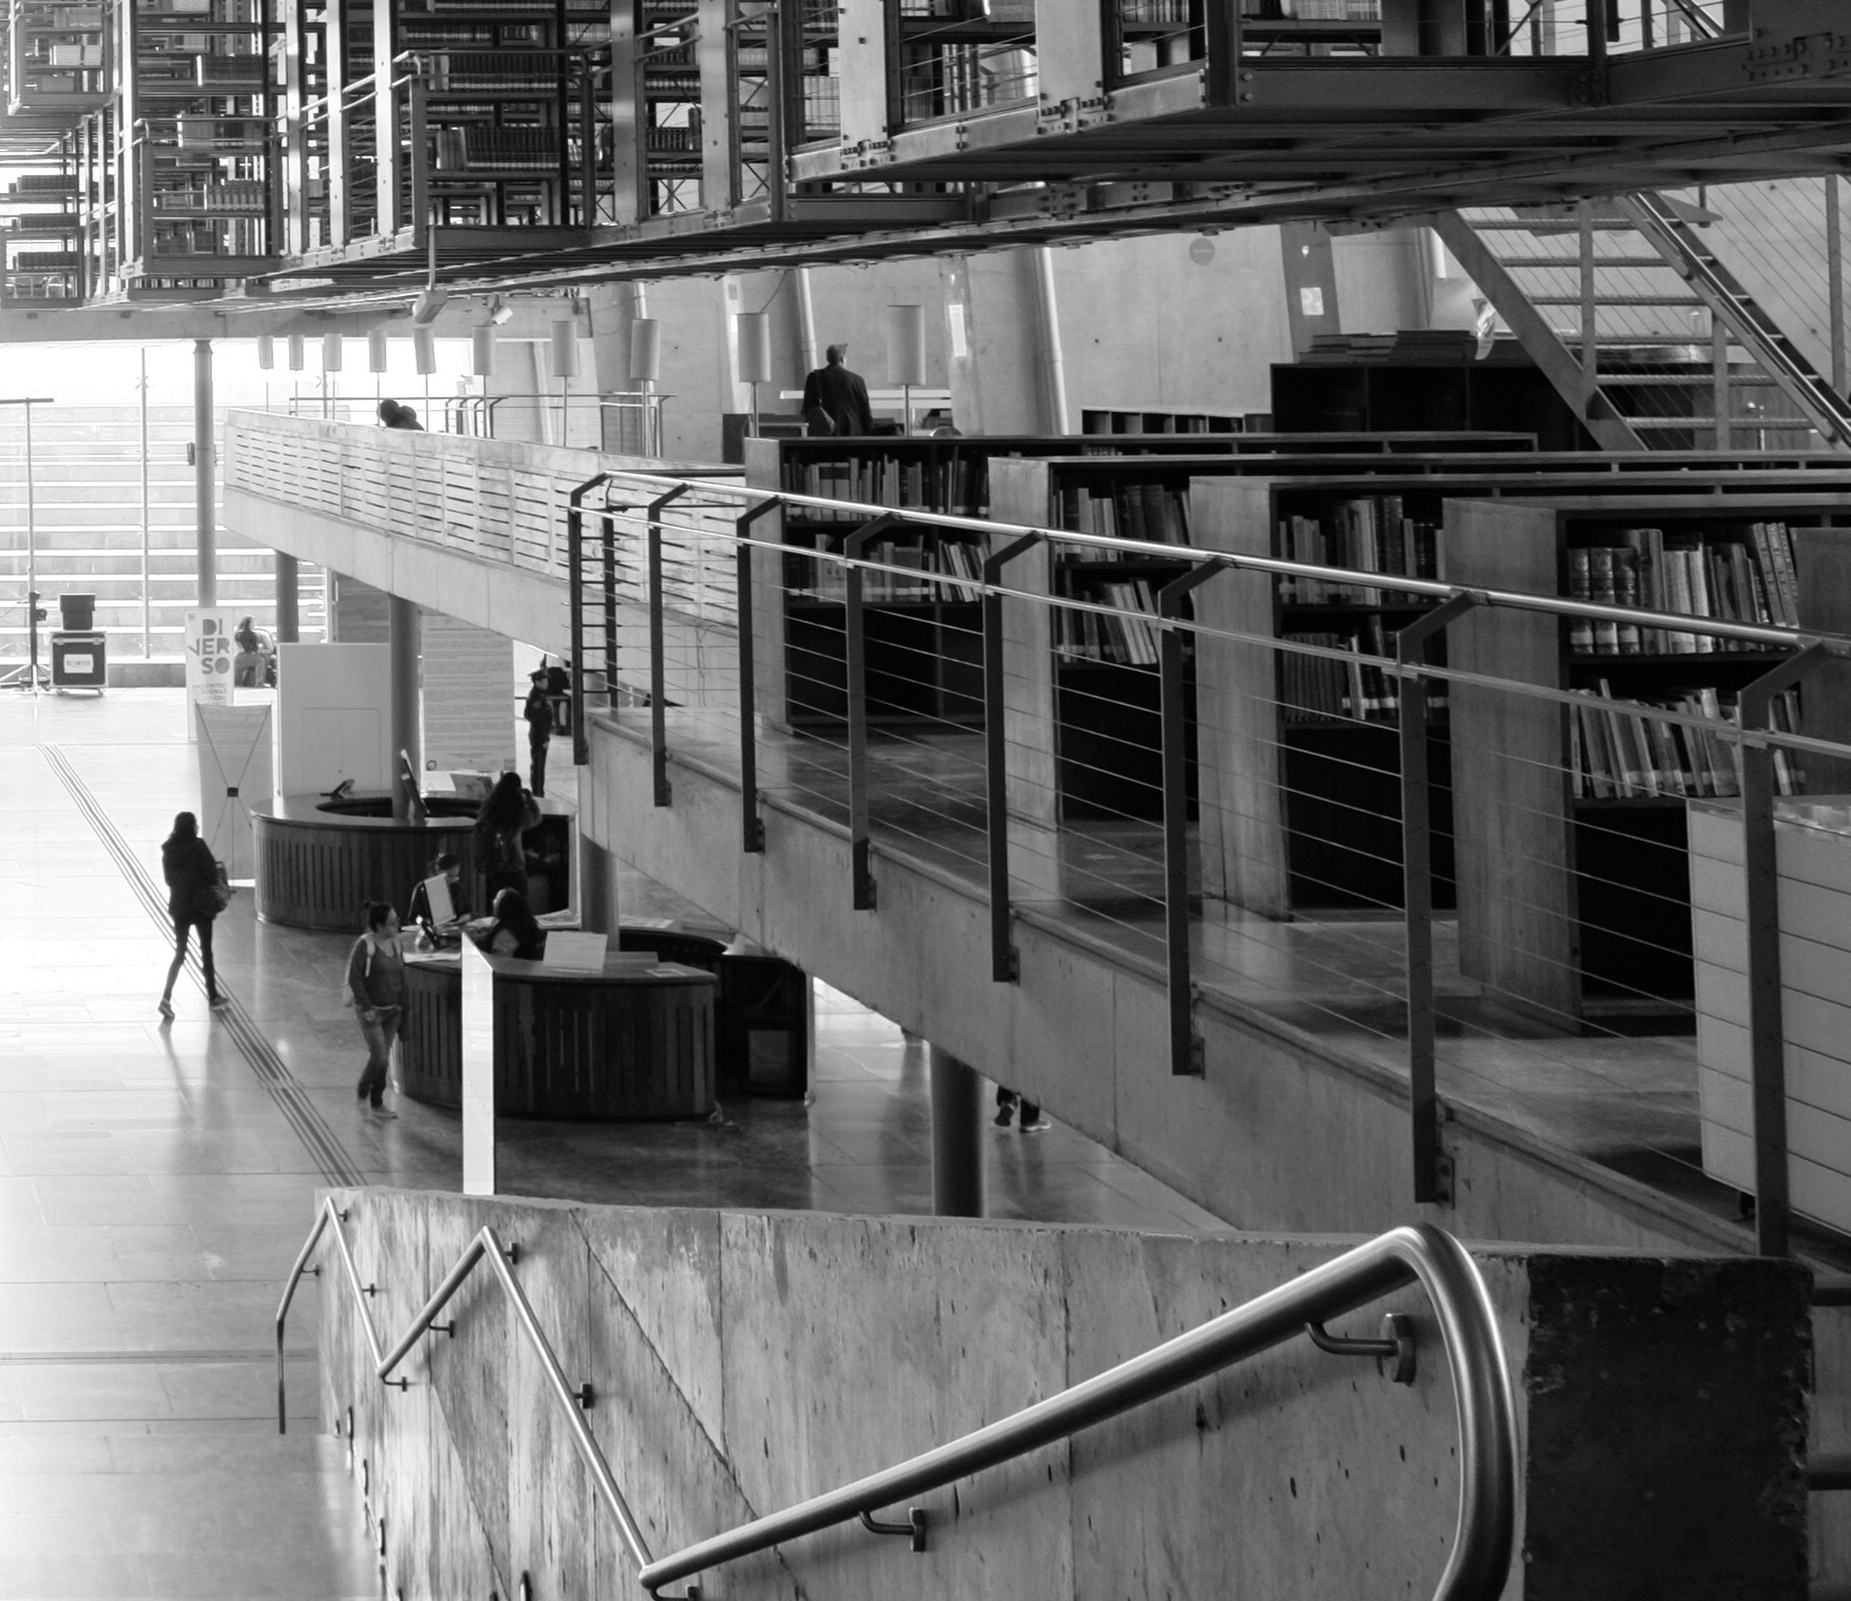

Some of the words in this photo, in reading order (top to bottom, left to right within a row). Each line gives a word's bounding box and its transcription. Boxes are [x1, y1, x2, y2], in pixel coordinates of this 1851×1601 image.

[202, 617, 223, 636] DI
[187, 637, 230, 657] VER
[201, 656, 230, 675] SO
